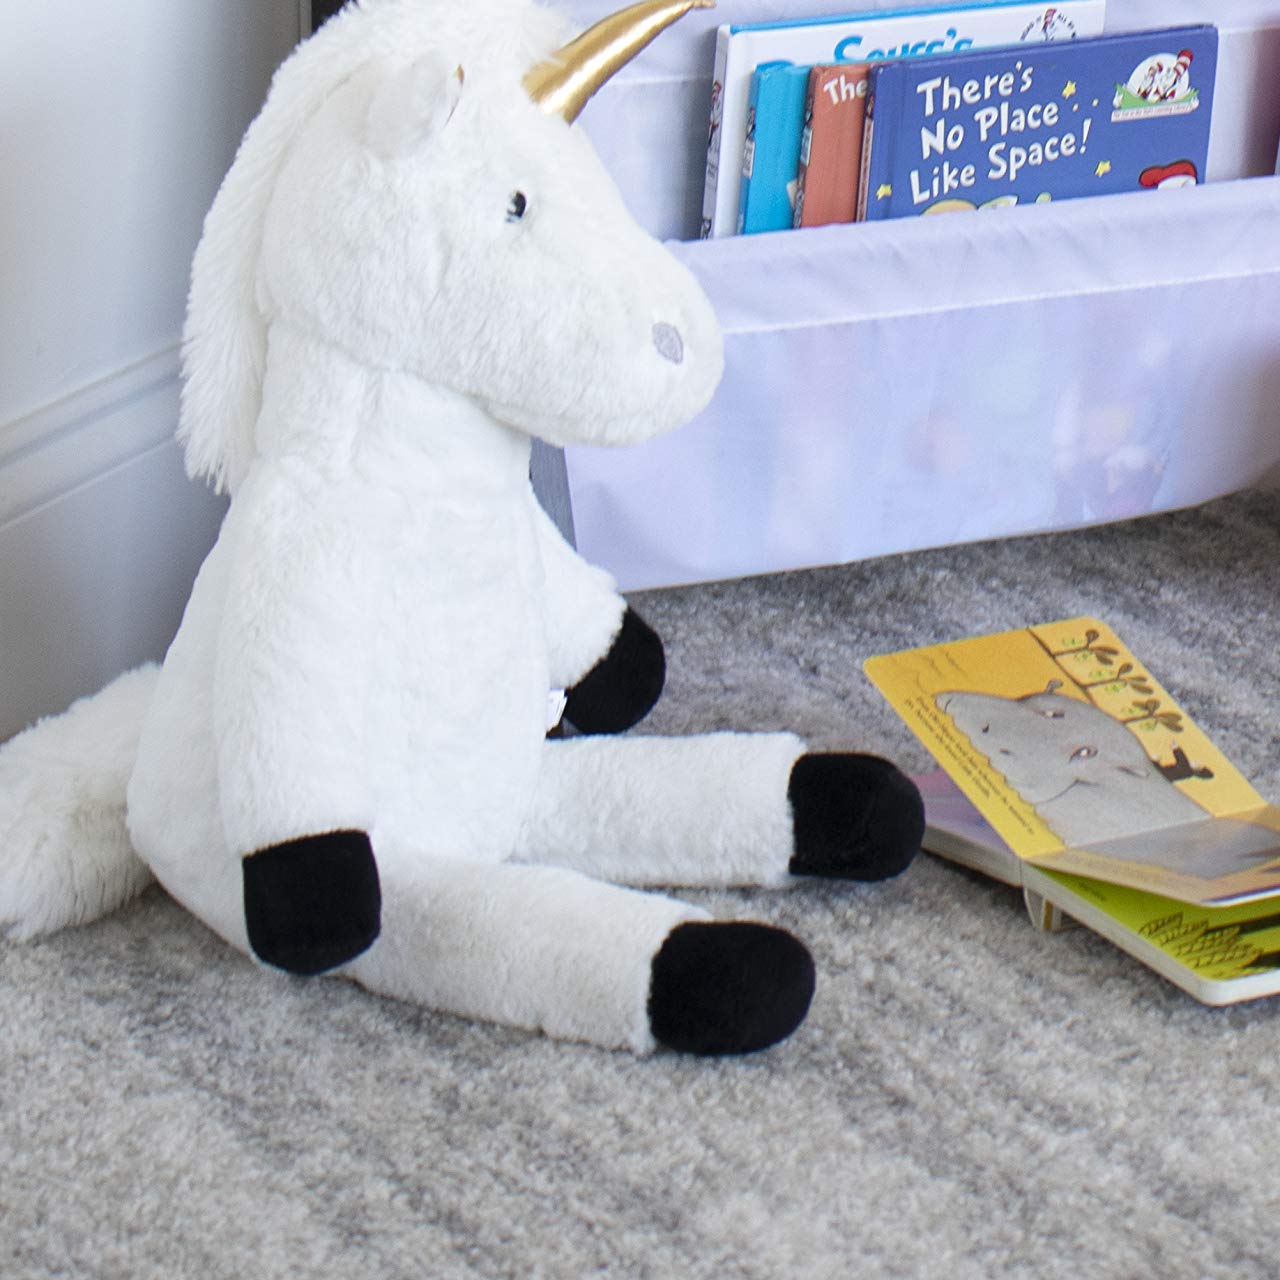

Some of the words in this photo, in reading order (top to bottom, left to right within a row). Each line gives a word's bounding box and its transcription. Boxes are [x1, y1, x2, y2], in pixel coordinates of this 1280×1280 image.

[823, 73, 868, 106] The
[916, 60, 1034, 117] There's
[920, 117, 965, 161] No
[973, 101, 1060, 143] Place
[909, 160, 976, 206] Like
[987, 118, 1092, 183] Space!
